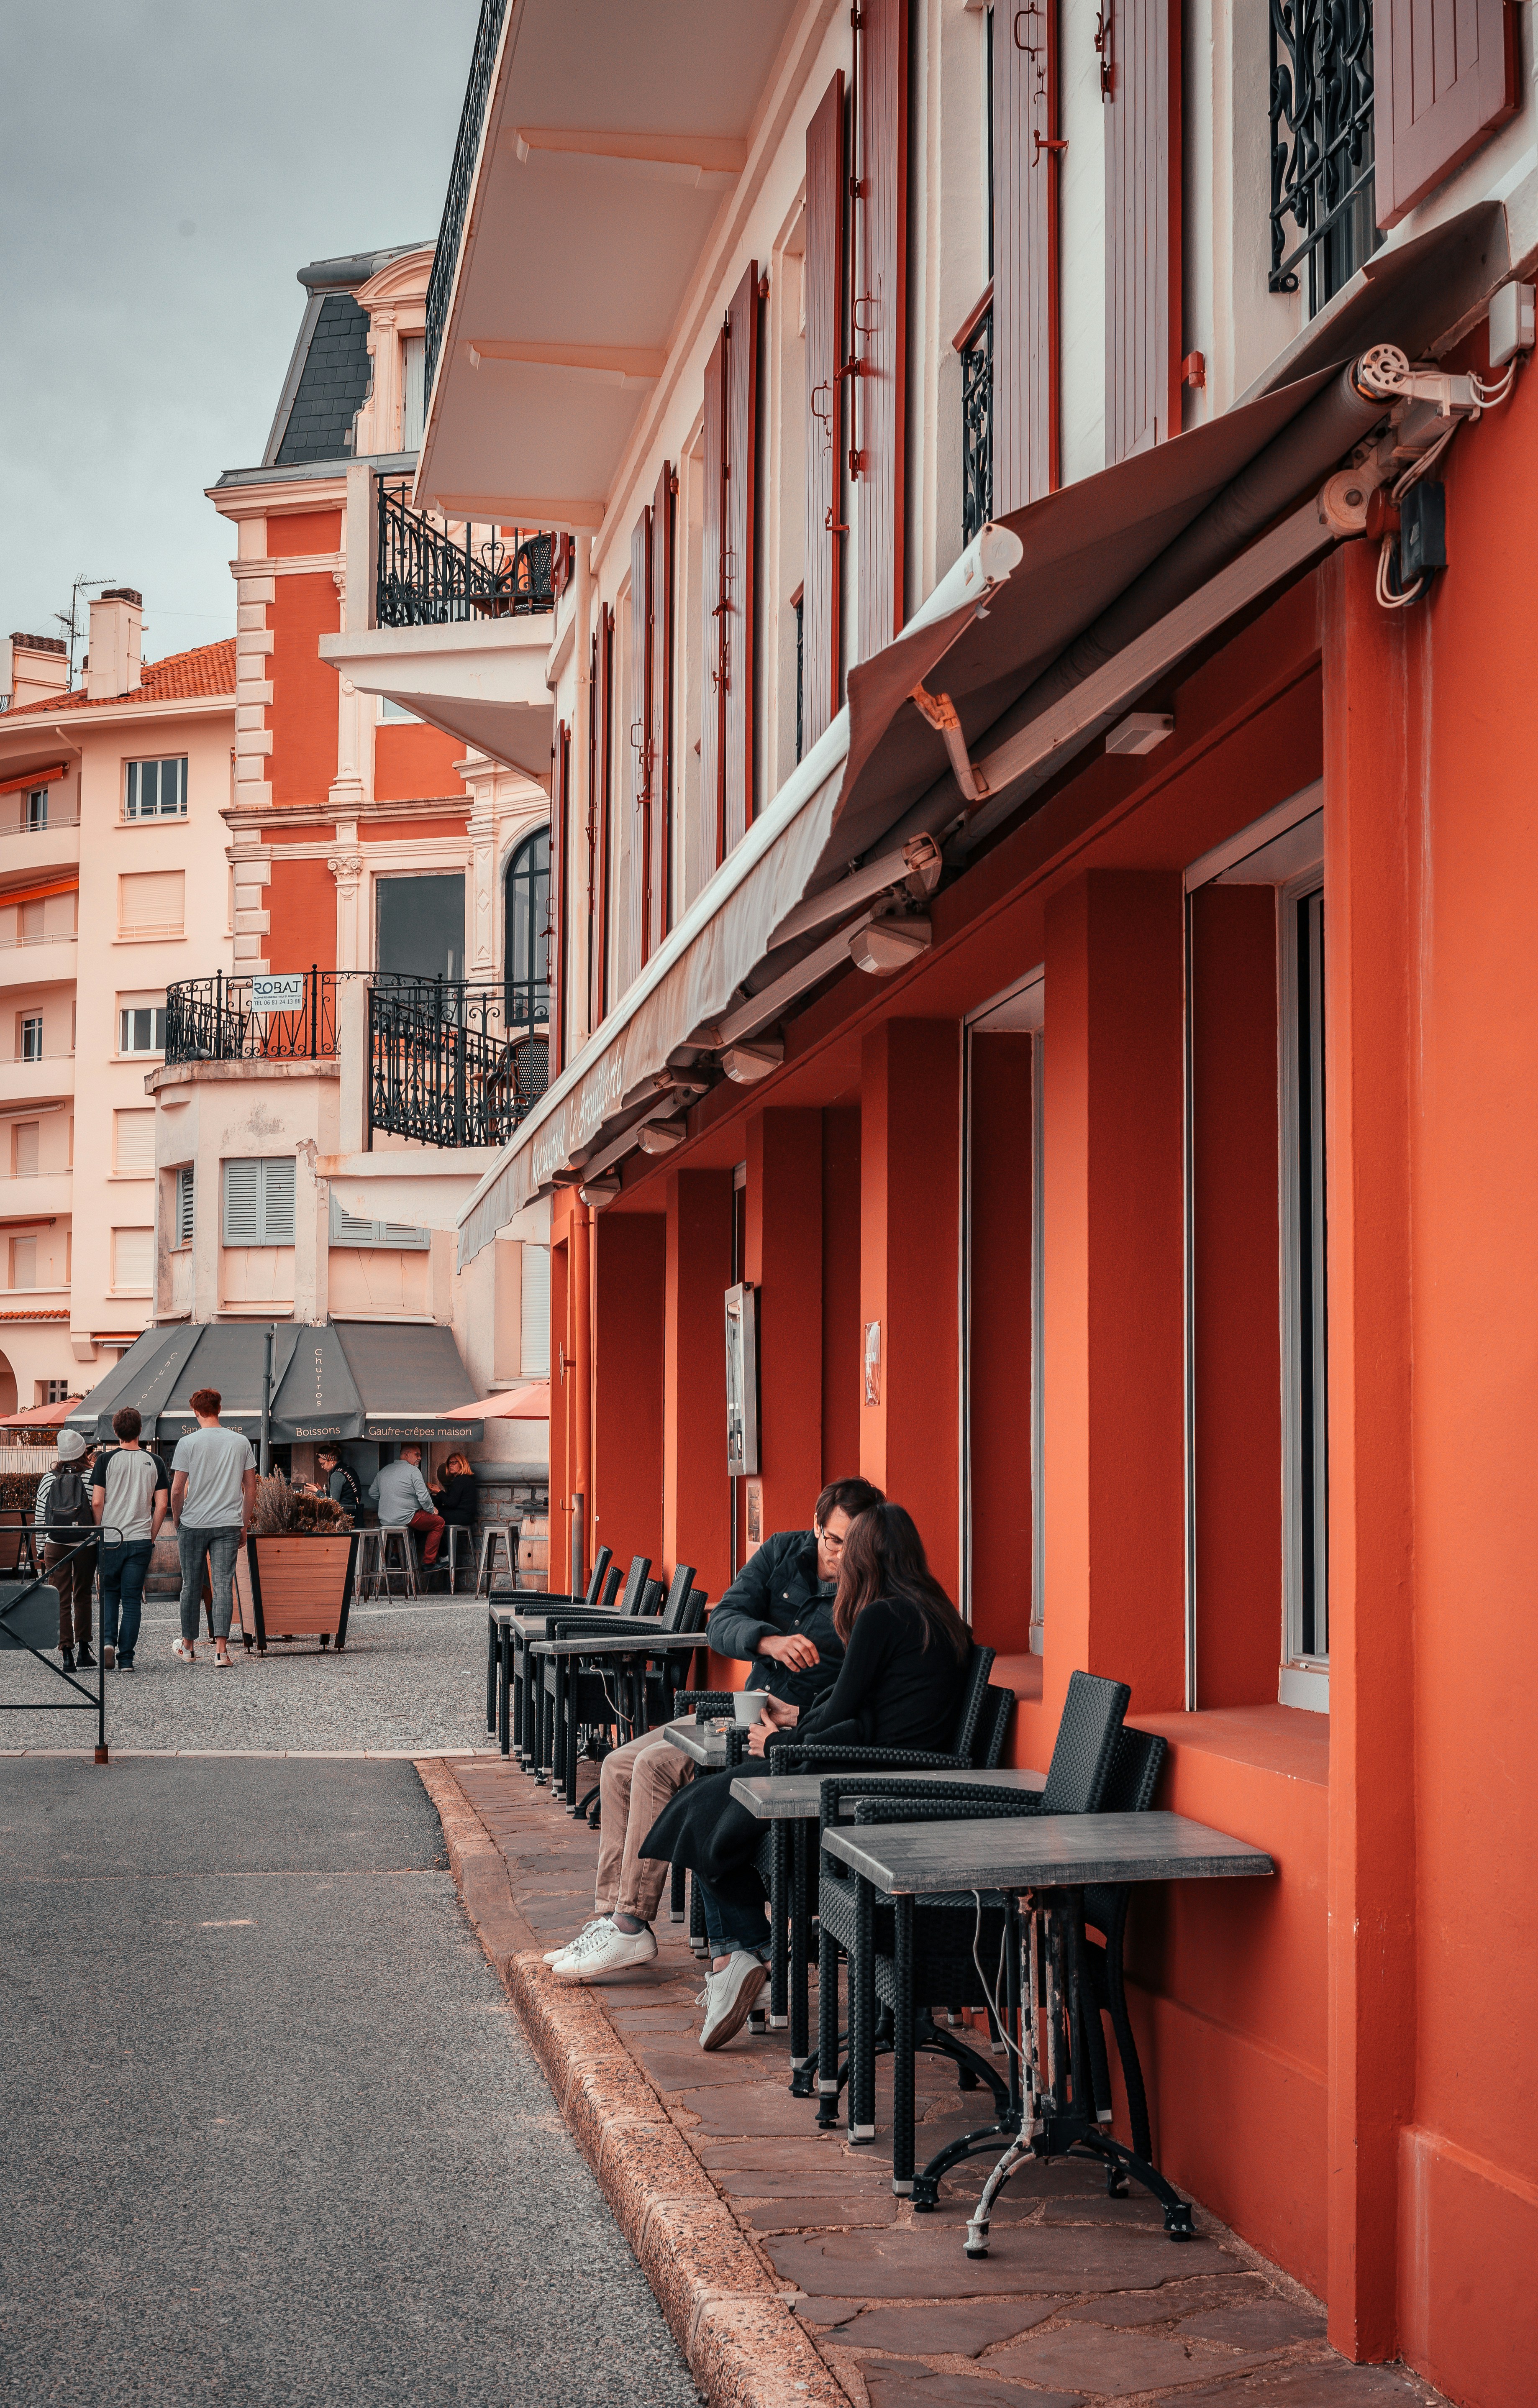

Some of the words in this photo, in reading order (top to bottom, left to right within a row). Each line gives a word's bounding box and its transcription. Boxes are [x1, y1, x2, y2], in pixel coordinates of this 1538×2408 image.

[254, 980, 301, 994] ROBAT
[136, 1352, 177, 1407] Churros
[295, 1427, 340, 1436] Boissons
[369, 1426, 435, 1437] Gaufre-crêpes
